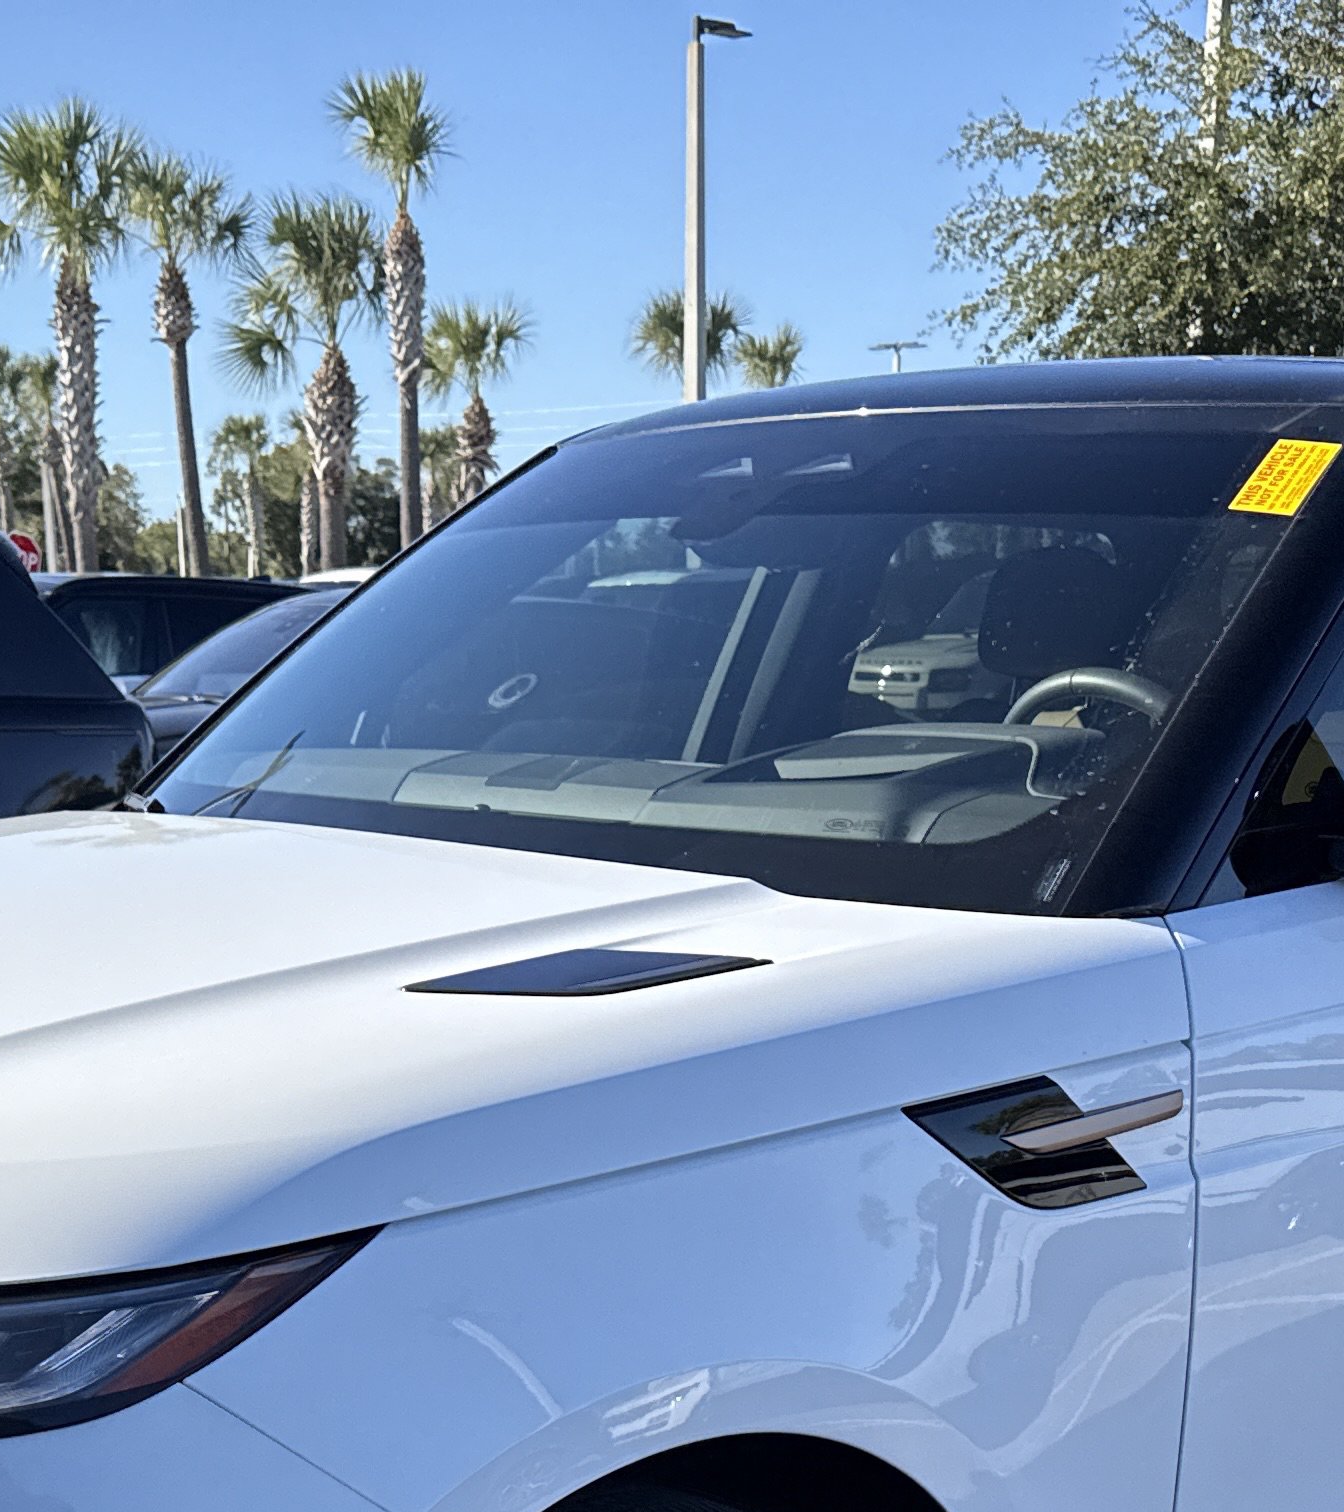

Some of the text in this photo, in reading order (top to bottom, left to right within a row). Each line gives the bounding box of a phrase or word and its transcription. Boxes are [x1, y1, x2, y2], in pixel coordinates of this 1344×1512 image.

[1236, 484, 1262, 506] THIS
[1253, 444, 1294, 482] VEHICLE
[1255, 446, 1306, 506] NOT FOR SALE
